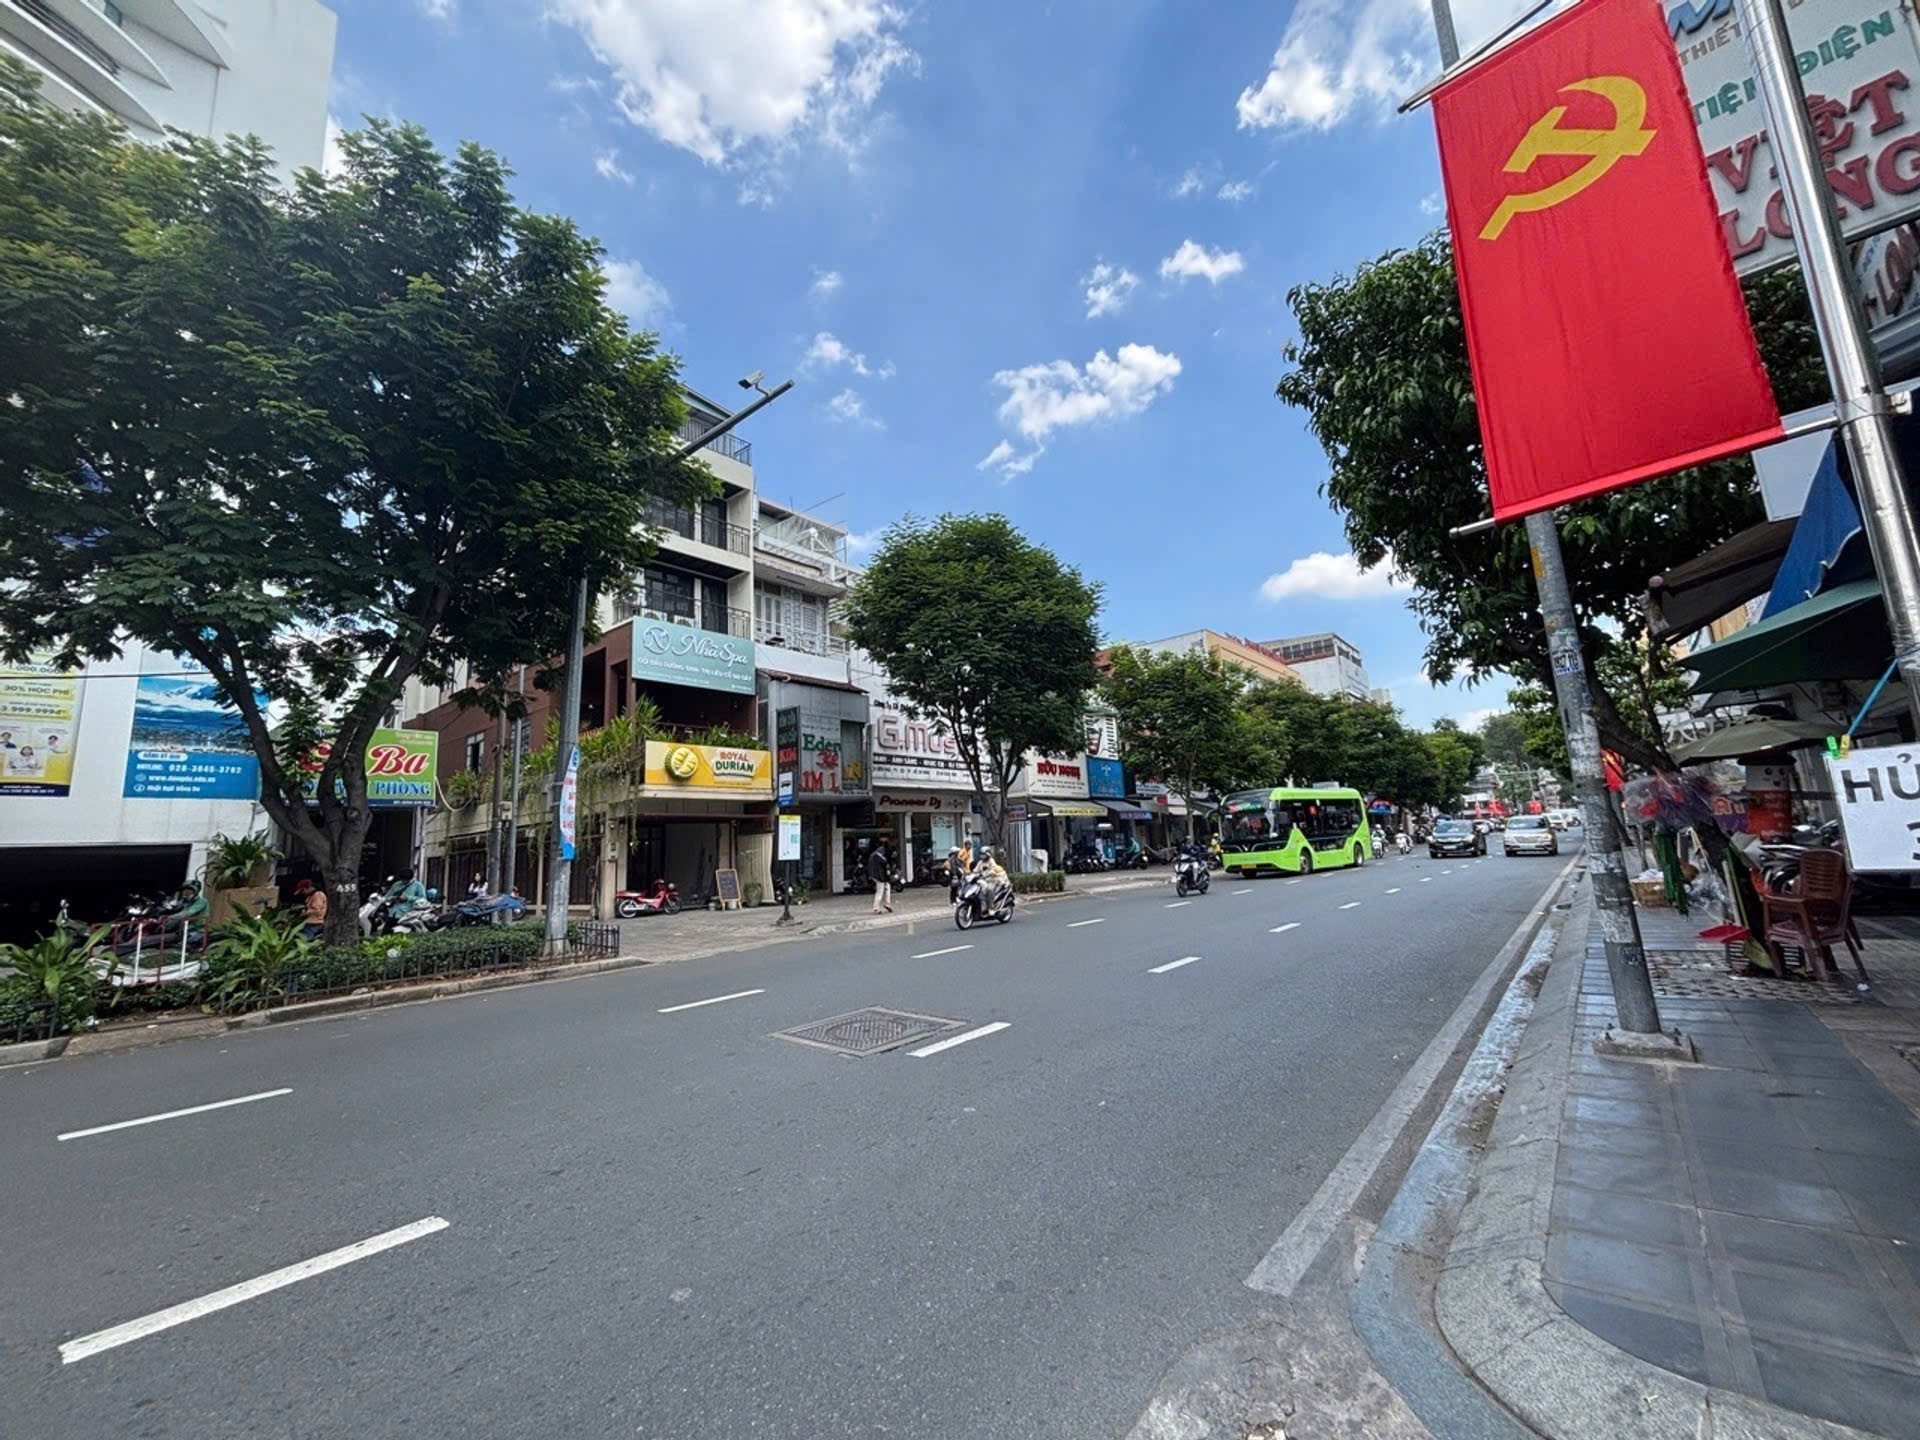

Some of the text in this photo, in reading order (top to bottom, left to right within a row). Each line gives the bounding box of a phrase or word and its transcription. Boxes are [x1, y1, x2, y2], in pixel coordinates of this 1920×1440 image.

[1704, 69, 1910, 194] VỆT
[718, 642, 749, 668] Spa
[803, 733, 841, 752] Eden
[367, 743, 431, 777] Ba
[720, 751, 748, 761] ROYAL
[715, 760, 754, 772] DURIAN
[880, 795, 927, 807] Pioneer
